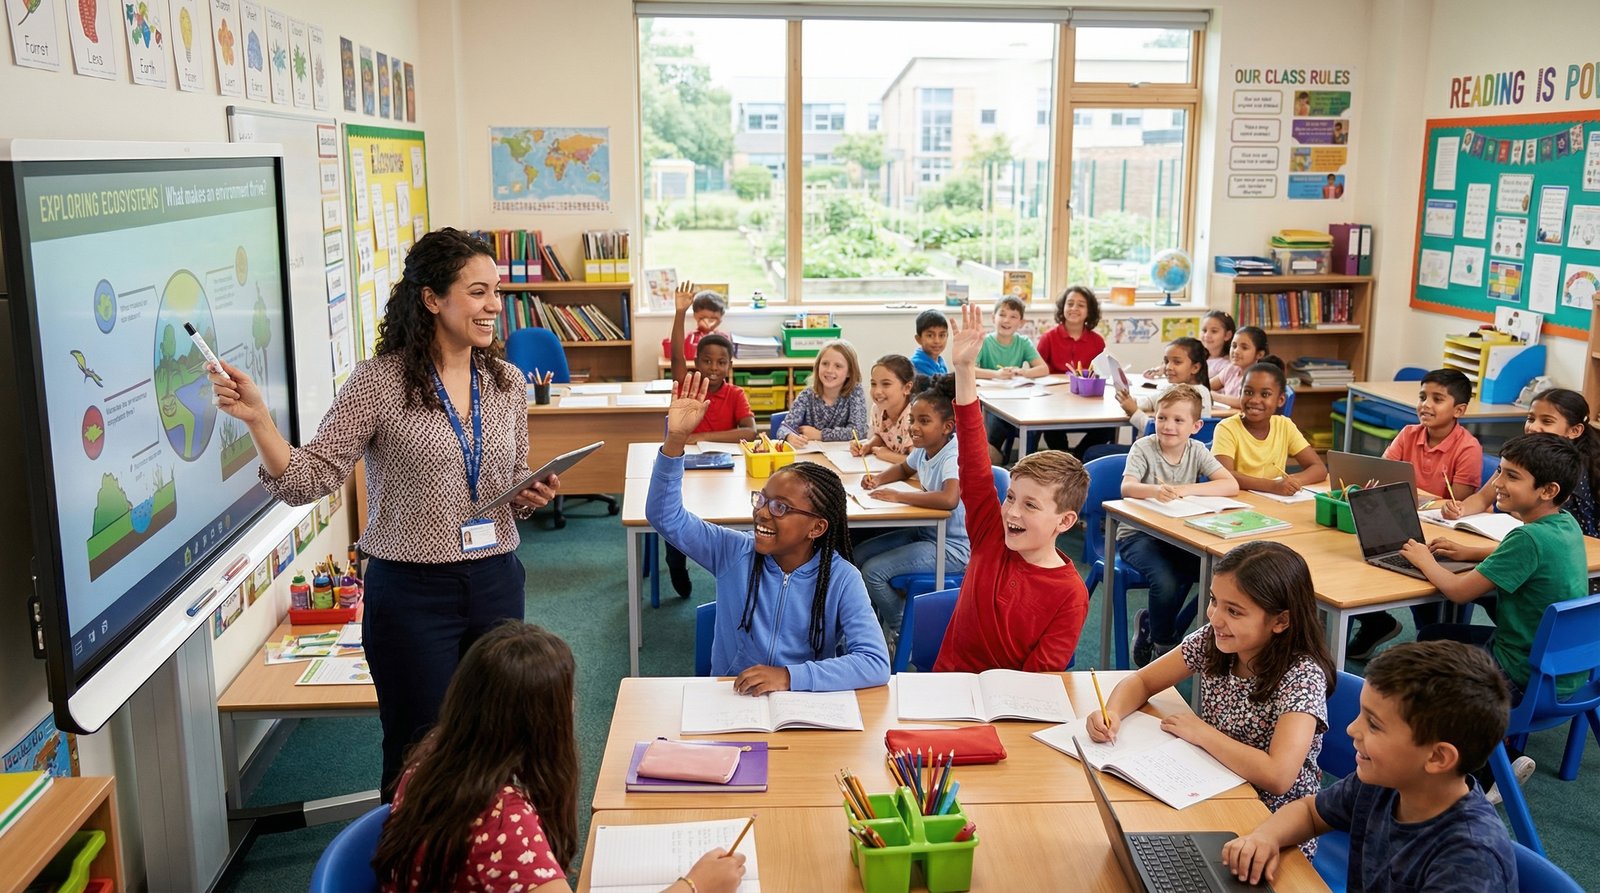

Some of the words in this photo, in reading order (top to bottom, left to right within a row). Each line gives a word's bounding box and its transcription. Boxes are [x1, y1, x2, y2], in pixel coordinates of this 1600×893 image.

[1235, 69, 1261, 84] OUR
[1265, 69, 1306, 84] CLASS
[1310, 70, 1350, 85] RULES
[1450, 70, 1525, 109] READING
[1536, 66, 1556, 103] IS
[1565, 61, 1600, 101] PO
[40, 191, 99, 223] EXPLORING
[102, 187, 159, 215] ECOSYSTEMS
[166, 185, 184, 207] What
[184, 185, 206, 204] makes
[206, 187, 215, 202] an
[215, 183, 249, 201] environment
